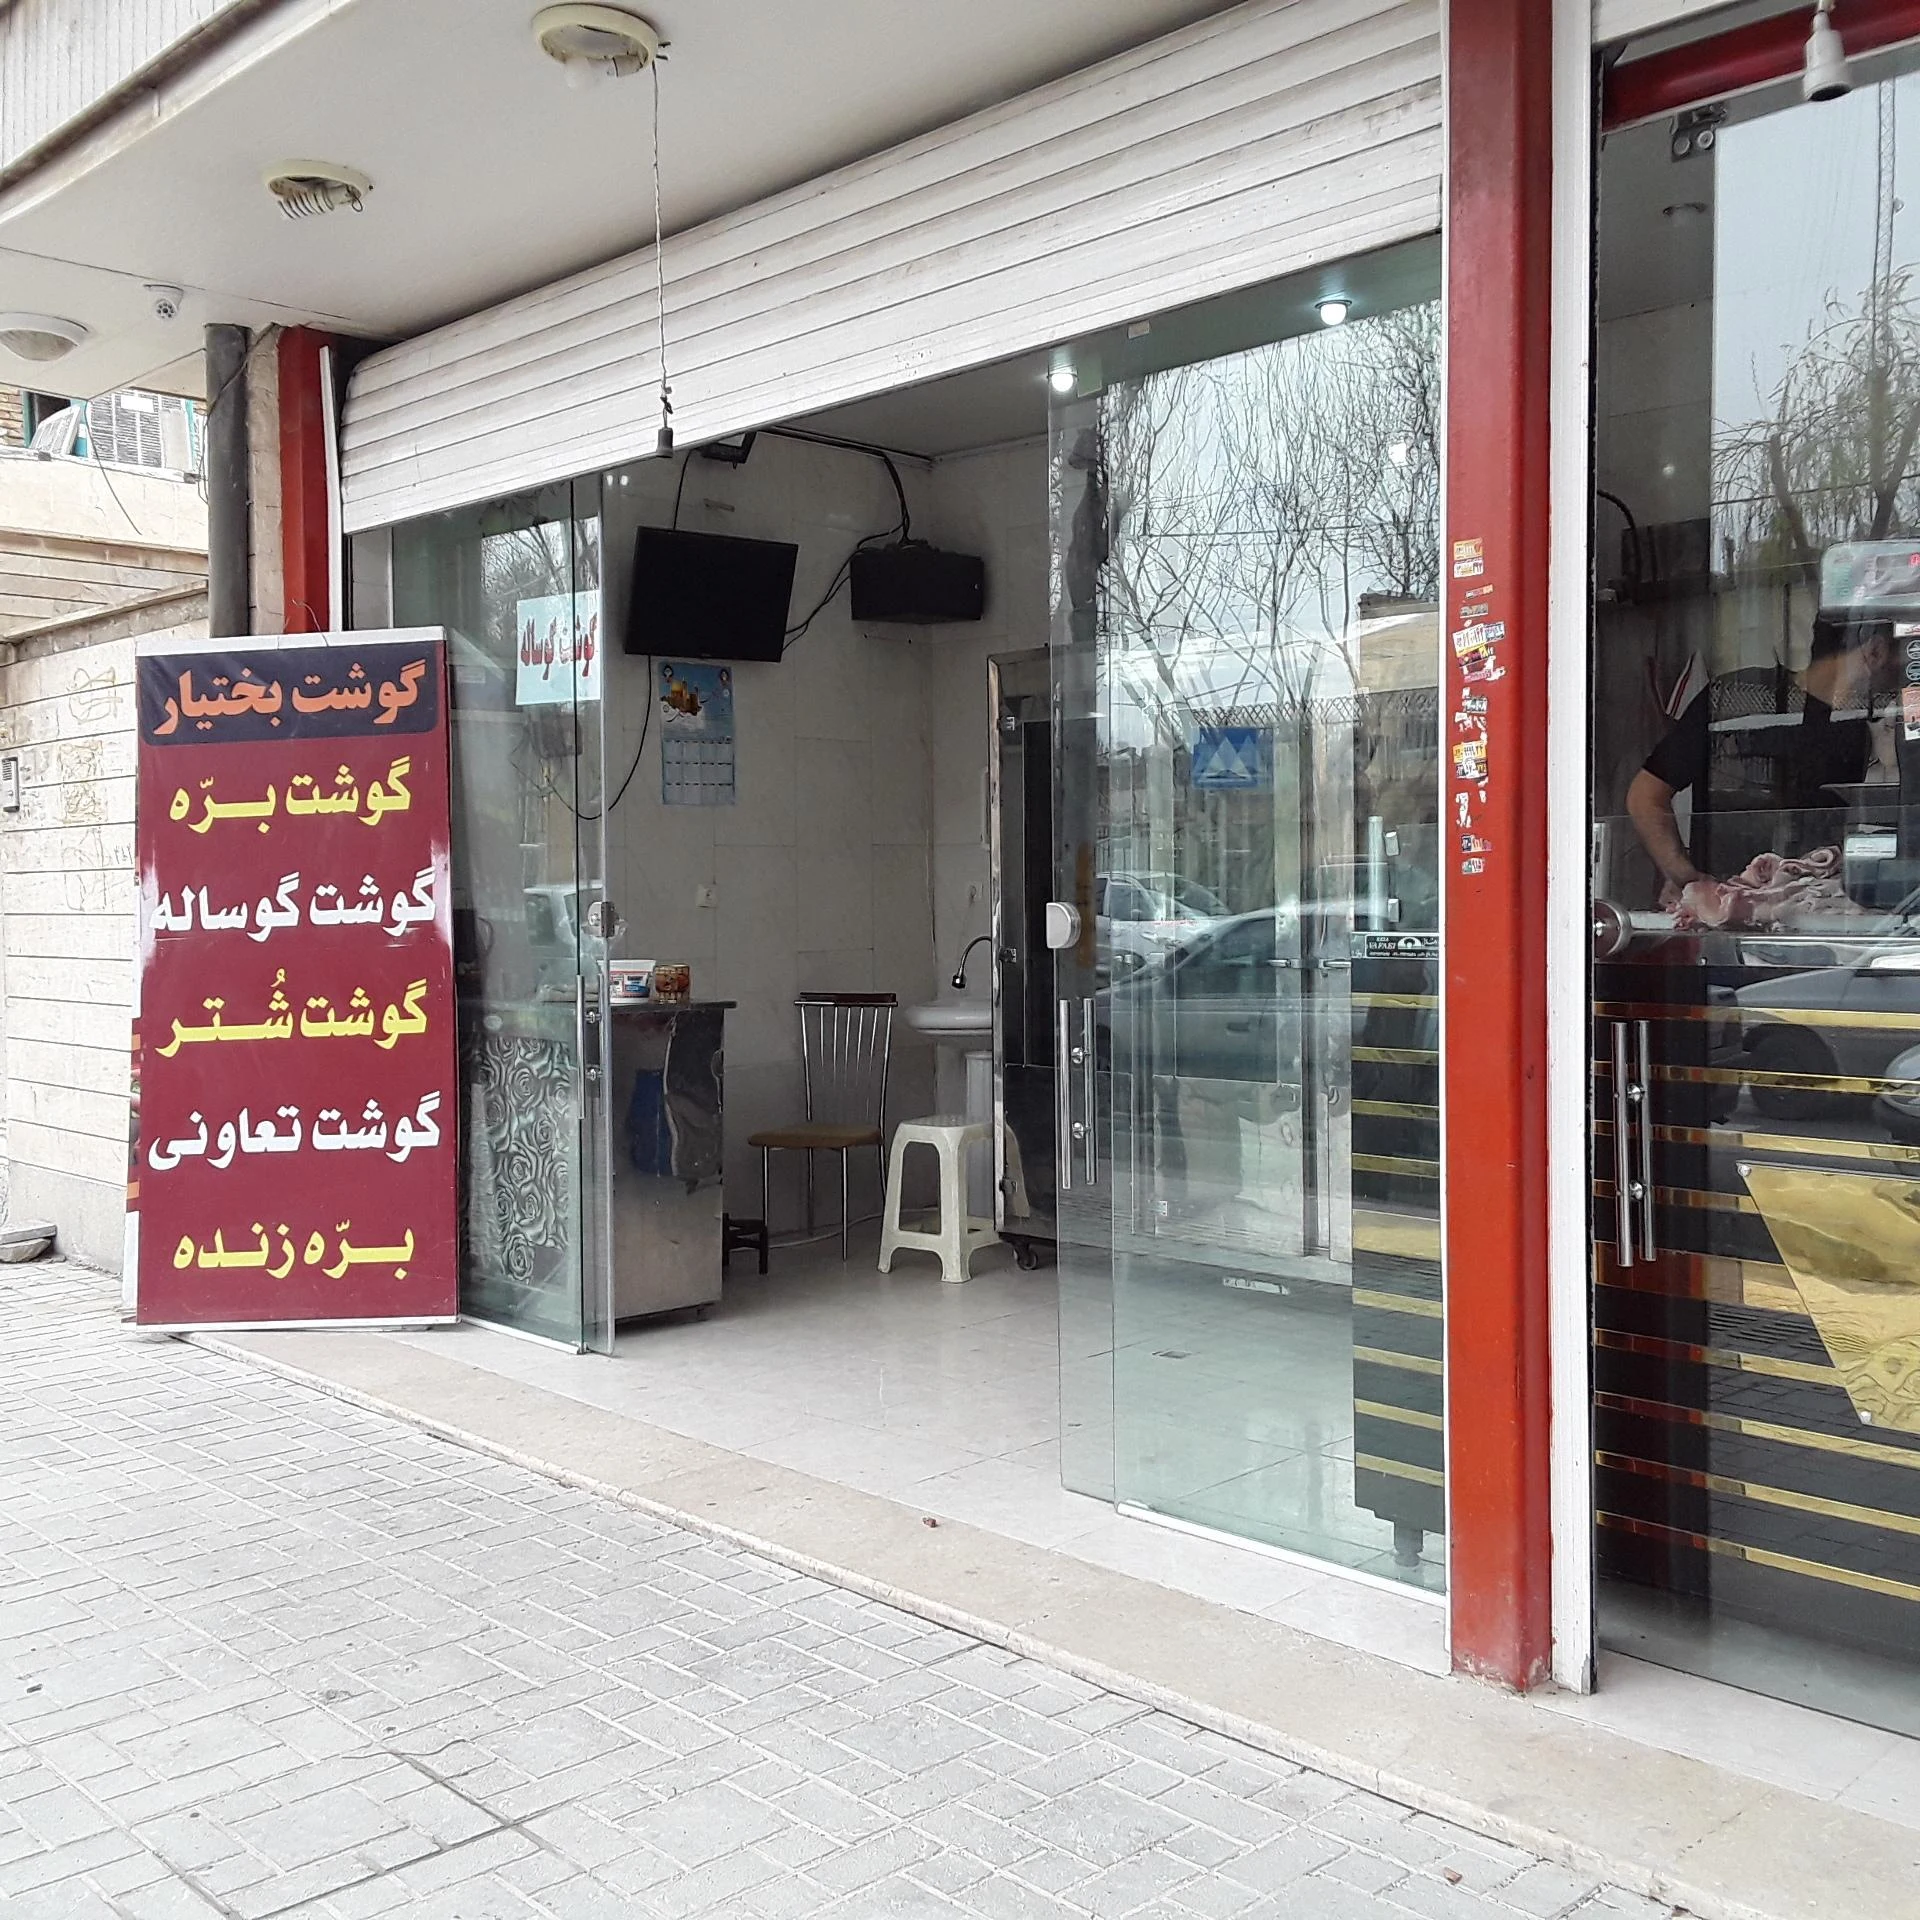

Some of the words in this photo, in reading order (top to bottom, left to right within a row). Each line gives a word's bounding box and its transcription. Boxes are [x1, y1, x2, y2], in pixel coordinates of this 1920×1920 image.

[154, 668, 282, 735] بختیار
[292, 659, 426, 724] گوشت
[286, 756, 411, 825] گوشت
[149, 872, 300, 943] گوساله
[309, 867, 437, 937] گوشت
[300, 978, 428, 1050] گوشت
[148, 1104, 300, 1171] تعاونی
[312, 1090, 441, 1163] گوشت
[172, 1222, 296, 1280] زنده
